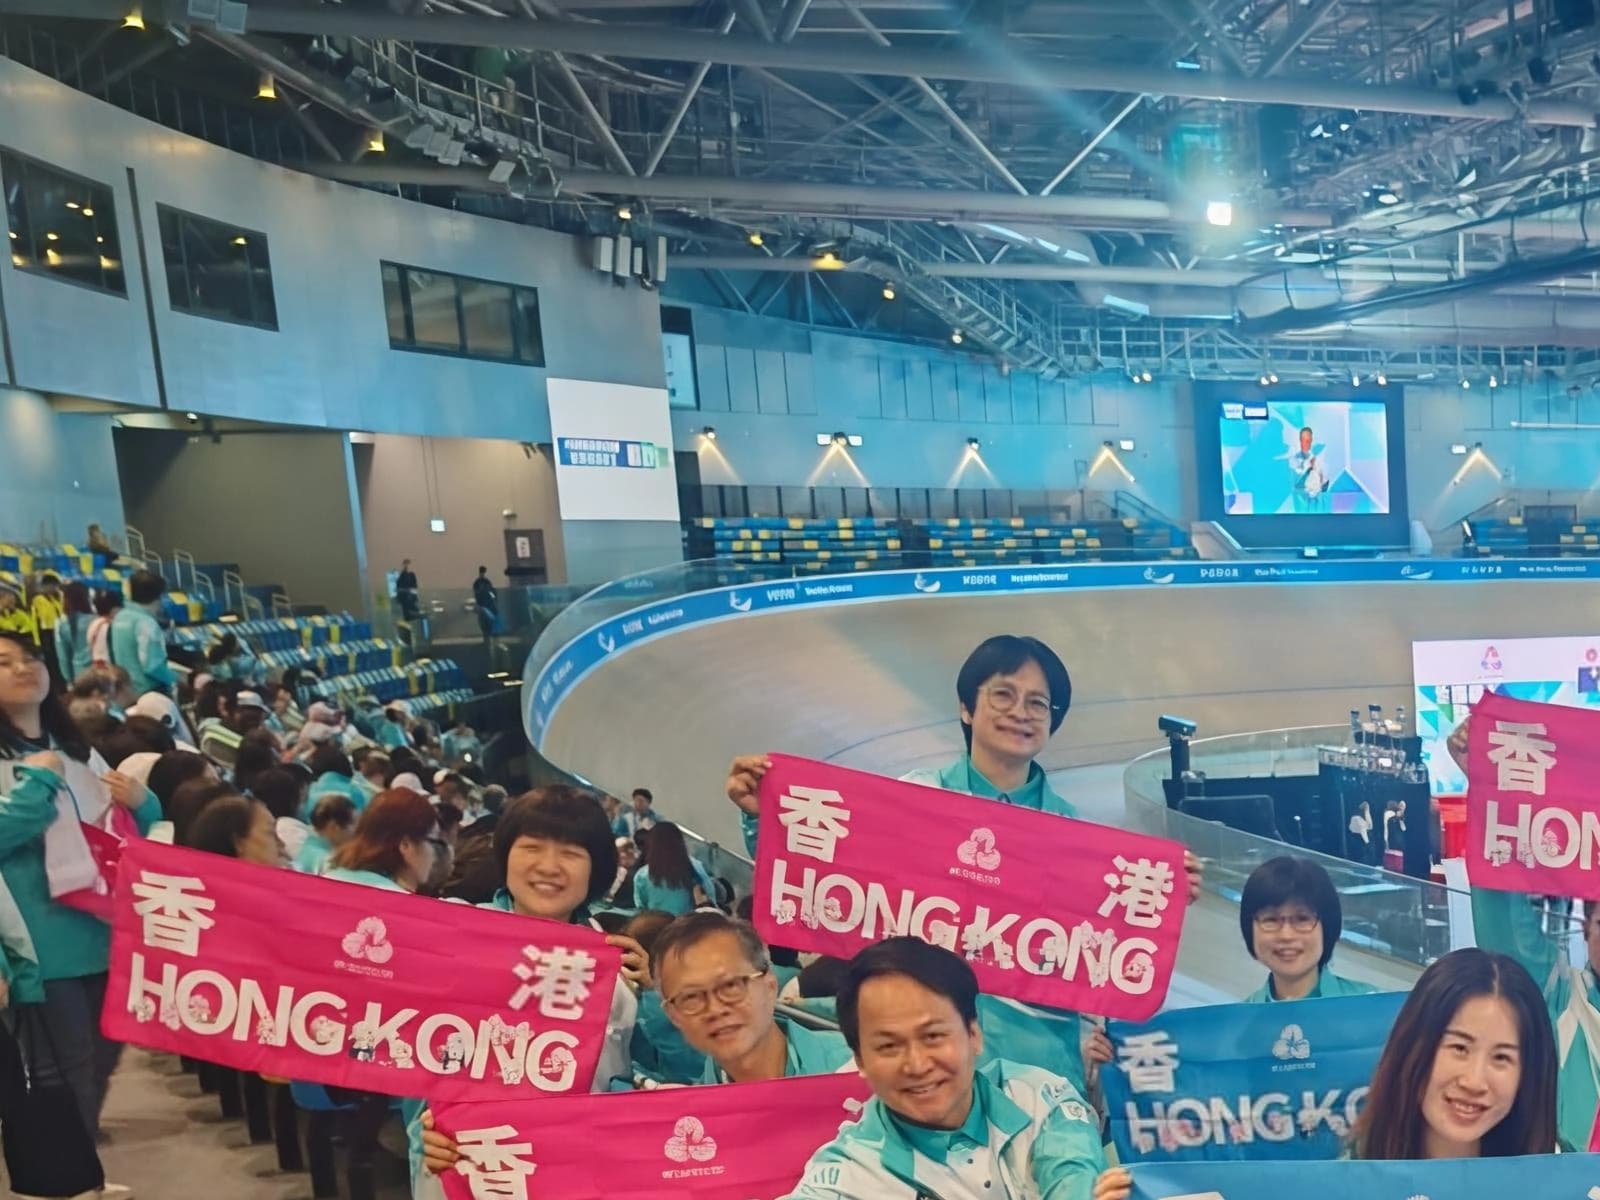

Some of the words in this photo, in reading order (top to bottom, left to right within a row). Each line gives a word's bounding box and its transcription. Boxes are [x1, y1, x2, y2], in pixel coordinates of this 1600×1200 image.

[1487, 719, 1557, 796] 香
[778, 784, 851, 863] 香
[1097, 854, 1175, 929] 港
[132, 870, 216, 957] 香
[508, 945, 596, 1021] 港
[1117, 1031, 1180, 1094] 香
